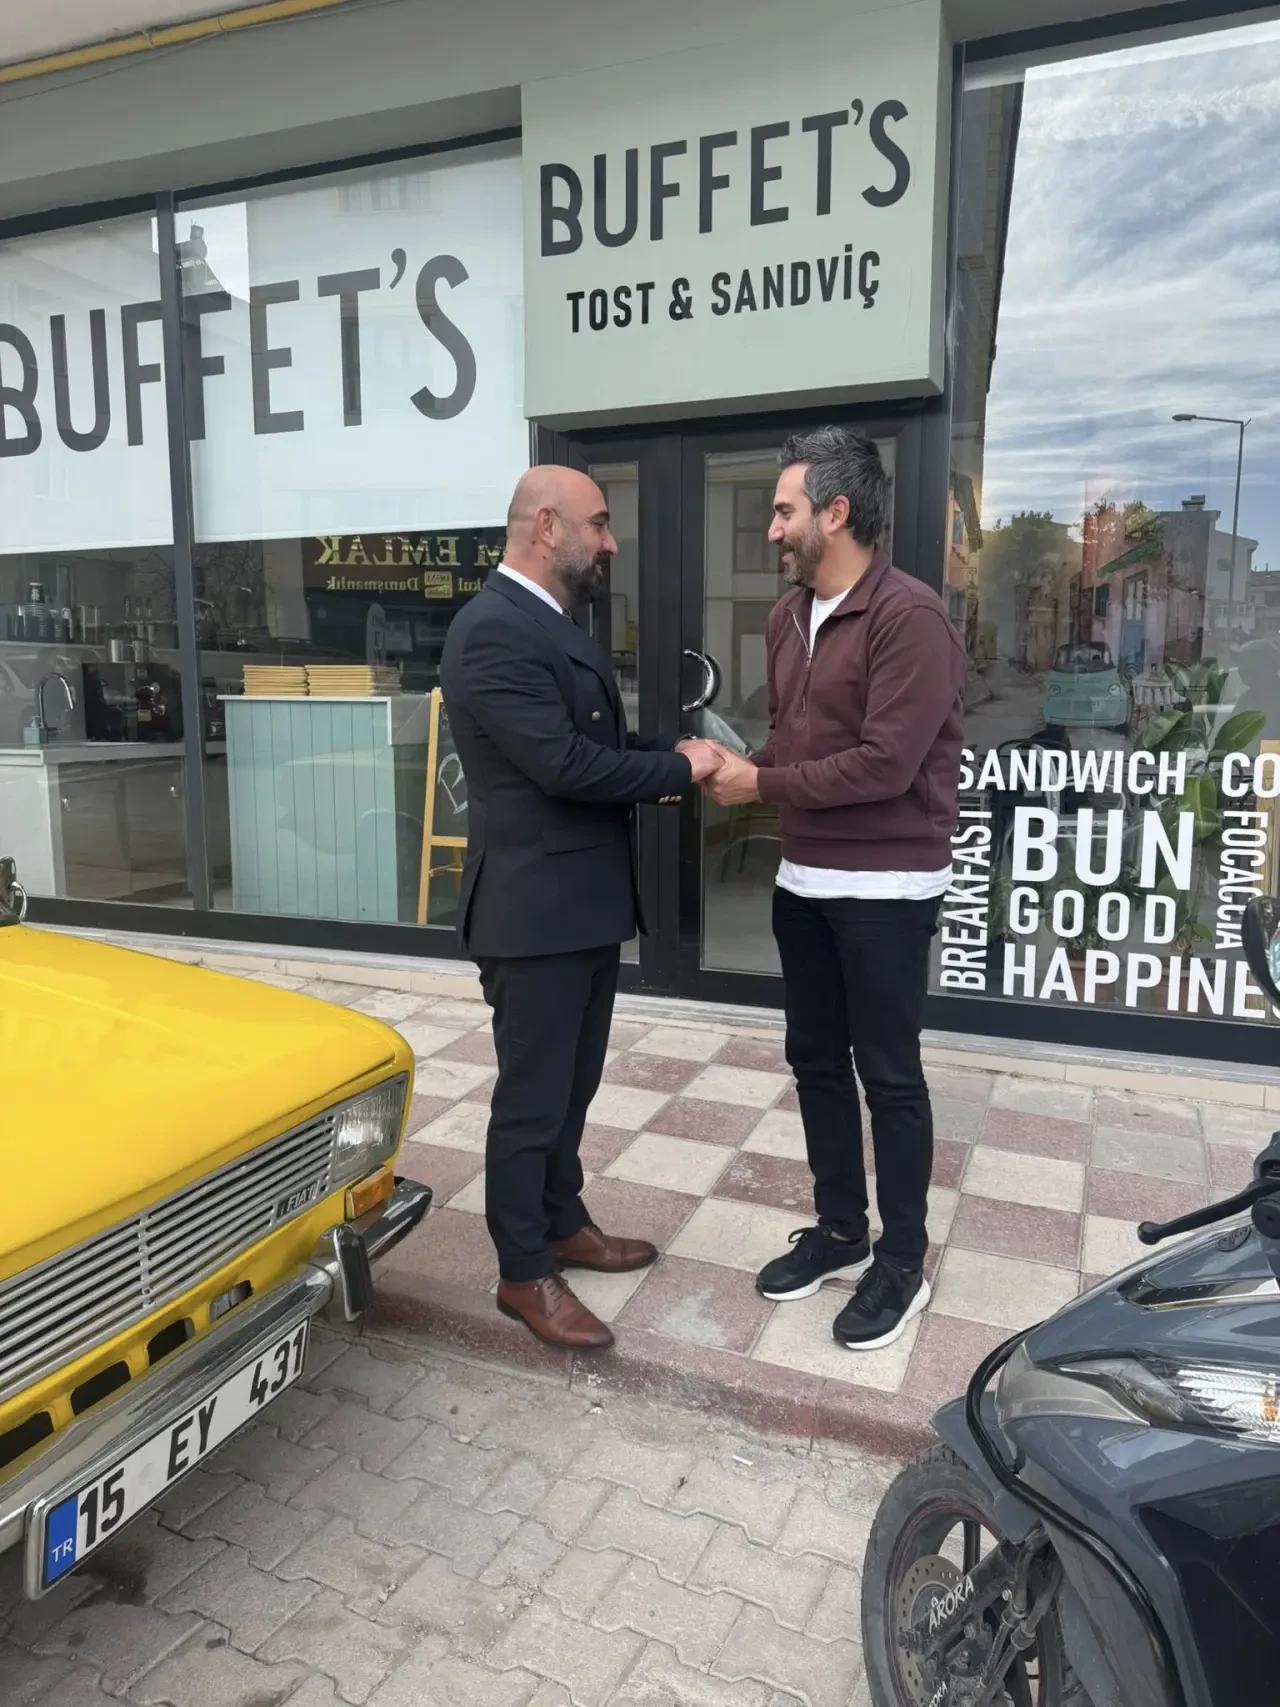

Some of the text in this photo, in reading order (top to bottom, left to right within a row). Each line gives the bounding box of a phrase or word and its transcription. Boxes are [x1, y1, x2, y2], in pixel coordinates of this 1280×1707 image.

[566, 243, 881, 333] TOST & SANDVİÇ
[958, 748, 1187, 795] SANDWICH
[1011, 805, 1195, 890] BUN
[1008, 887, 1177, 945] GOOD
[1002, 942, 1280, 1019] HAPPINE
[287, 1186, 314, 1212] FIAT
[51, 1326, 306, 1563] TR 15 EY 431
